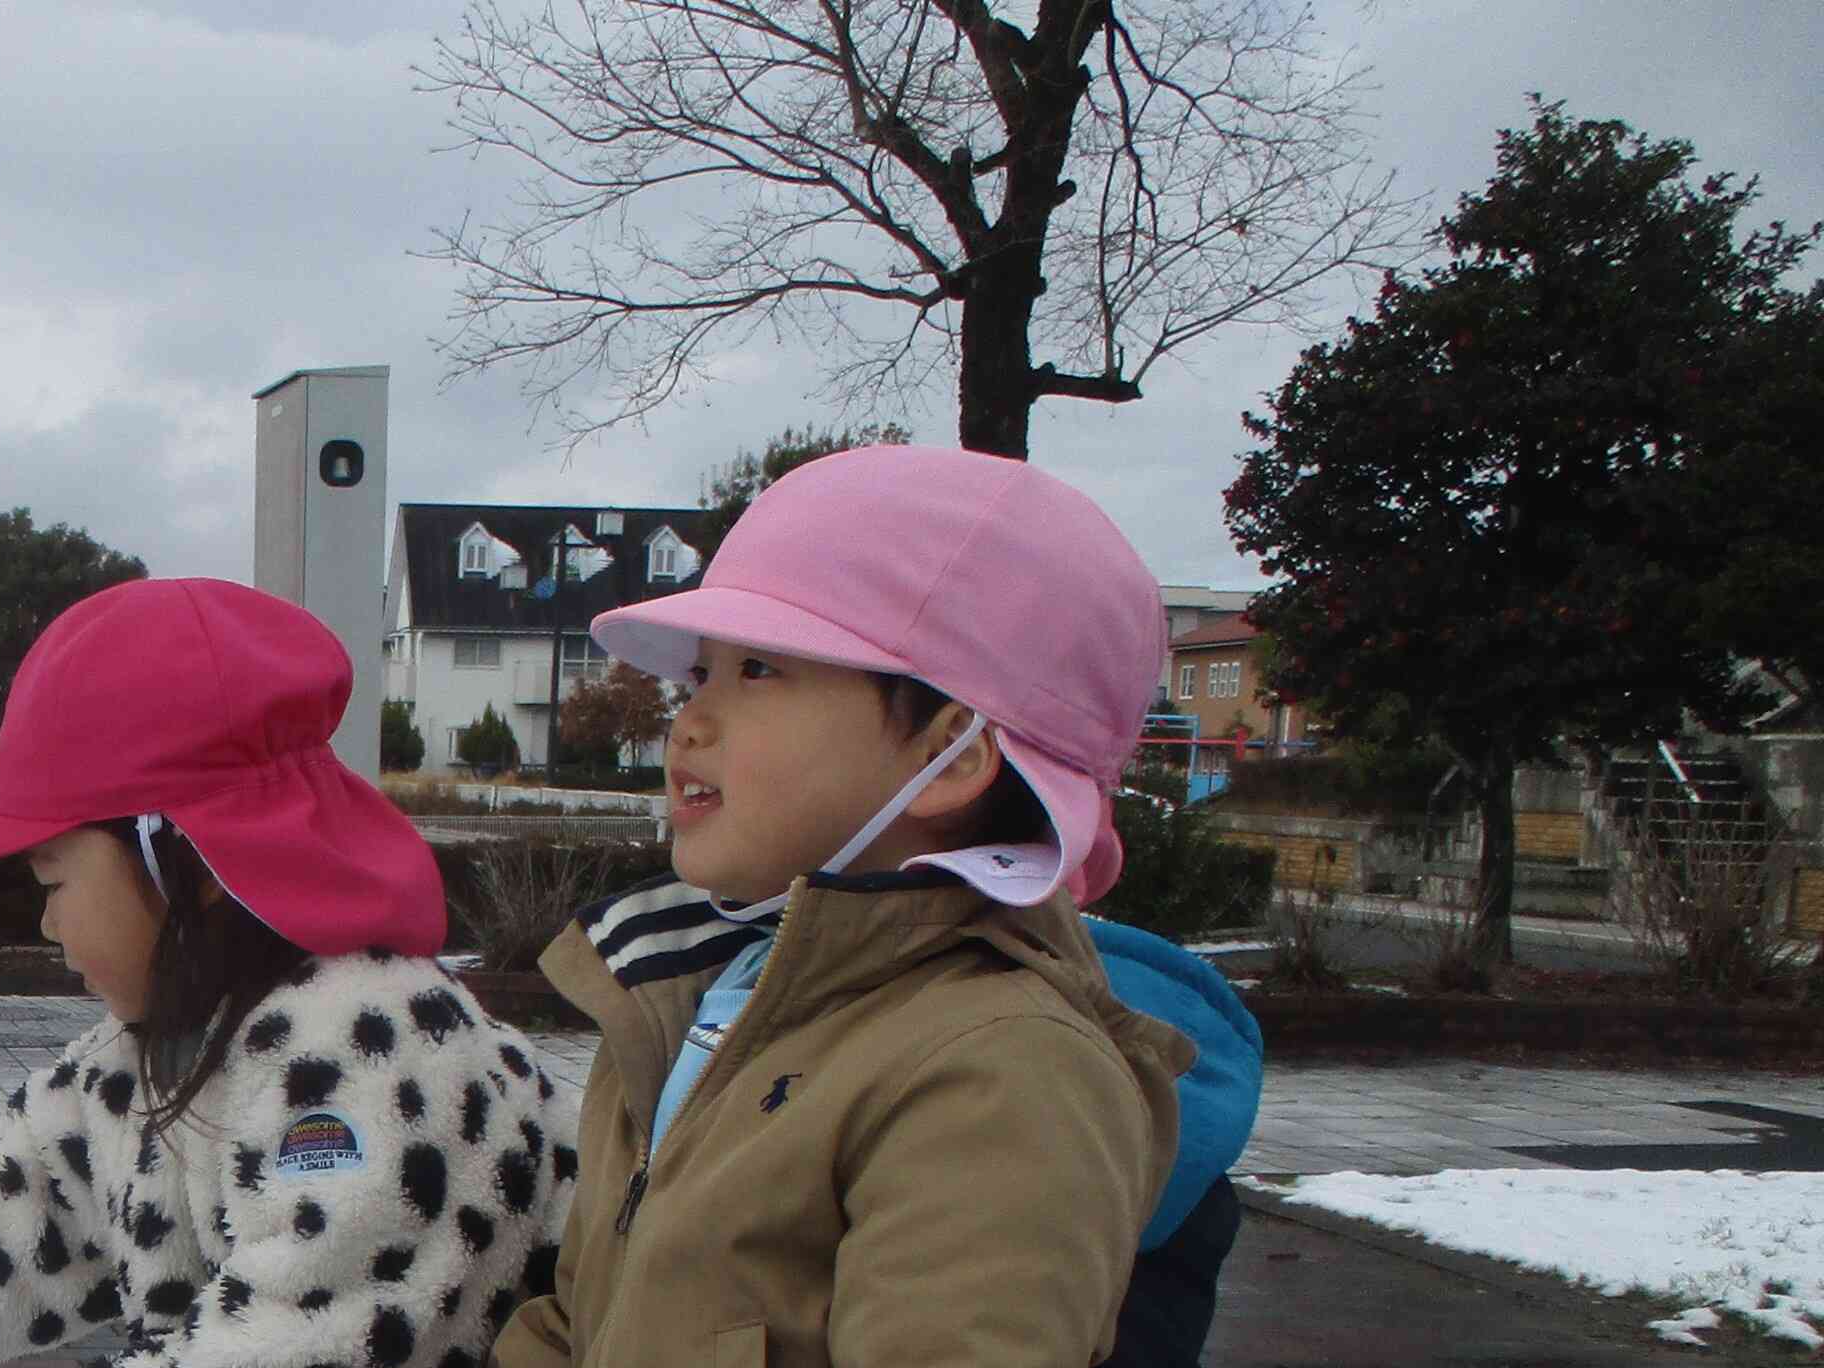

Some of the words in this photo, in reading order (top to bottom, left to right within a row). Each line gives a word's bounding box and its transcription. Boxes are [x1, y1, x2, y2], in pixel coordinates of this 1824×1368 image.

[288, 1121, 345, 1135] awesome
[301, 1151, 334, 1162] BEGINS
[336, 1152, 363, 1161] WITH
